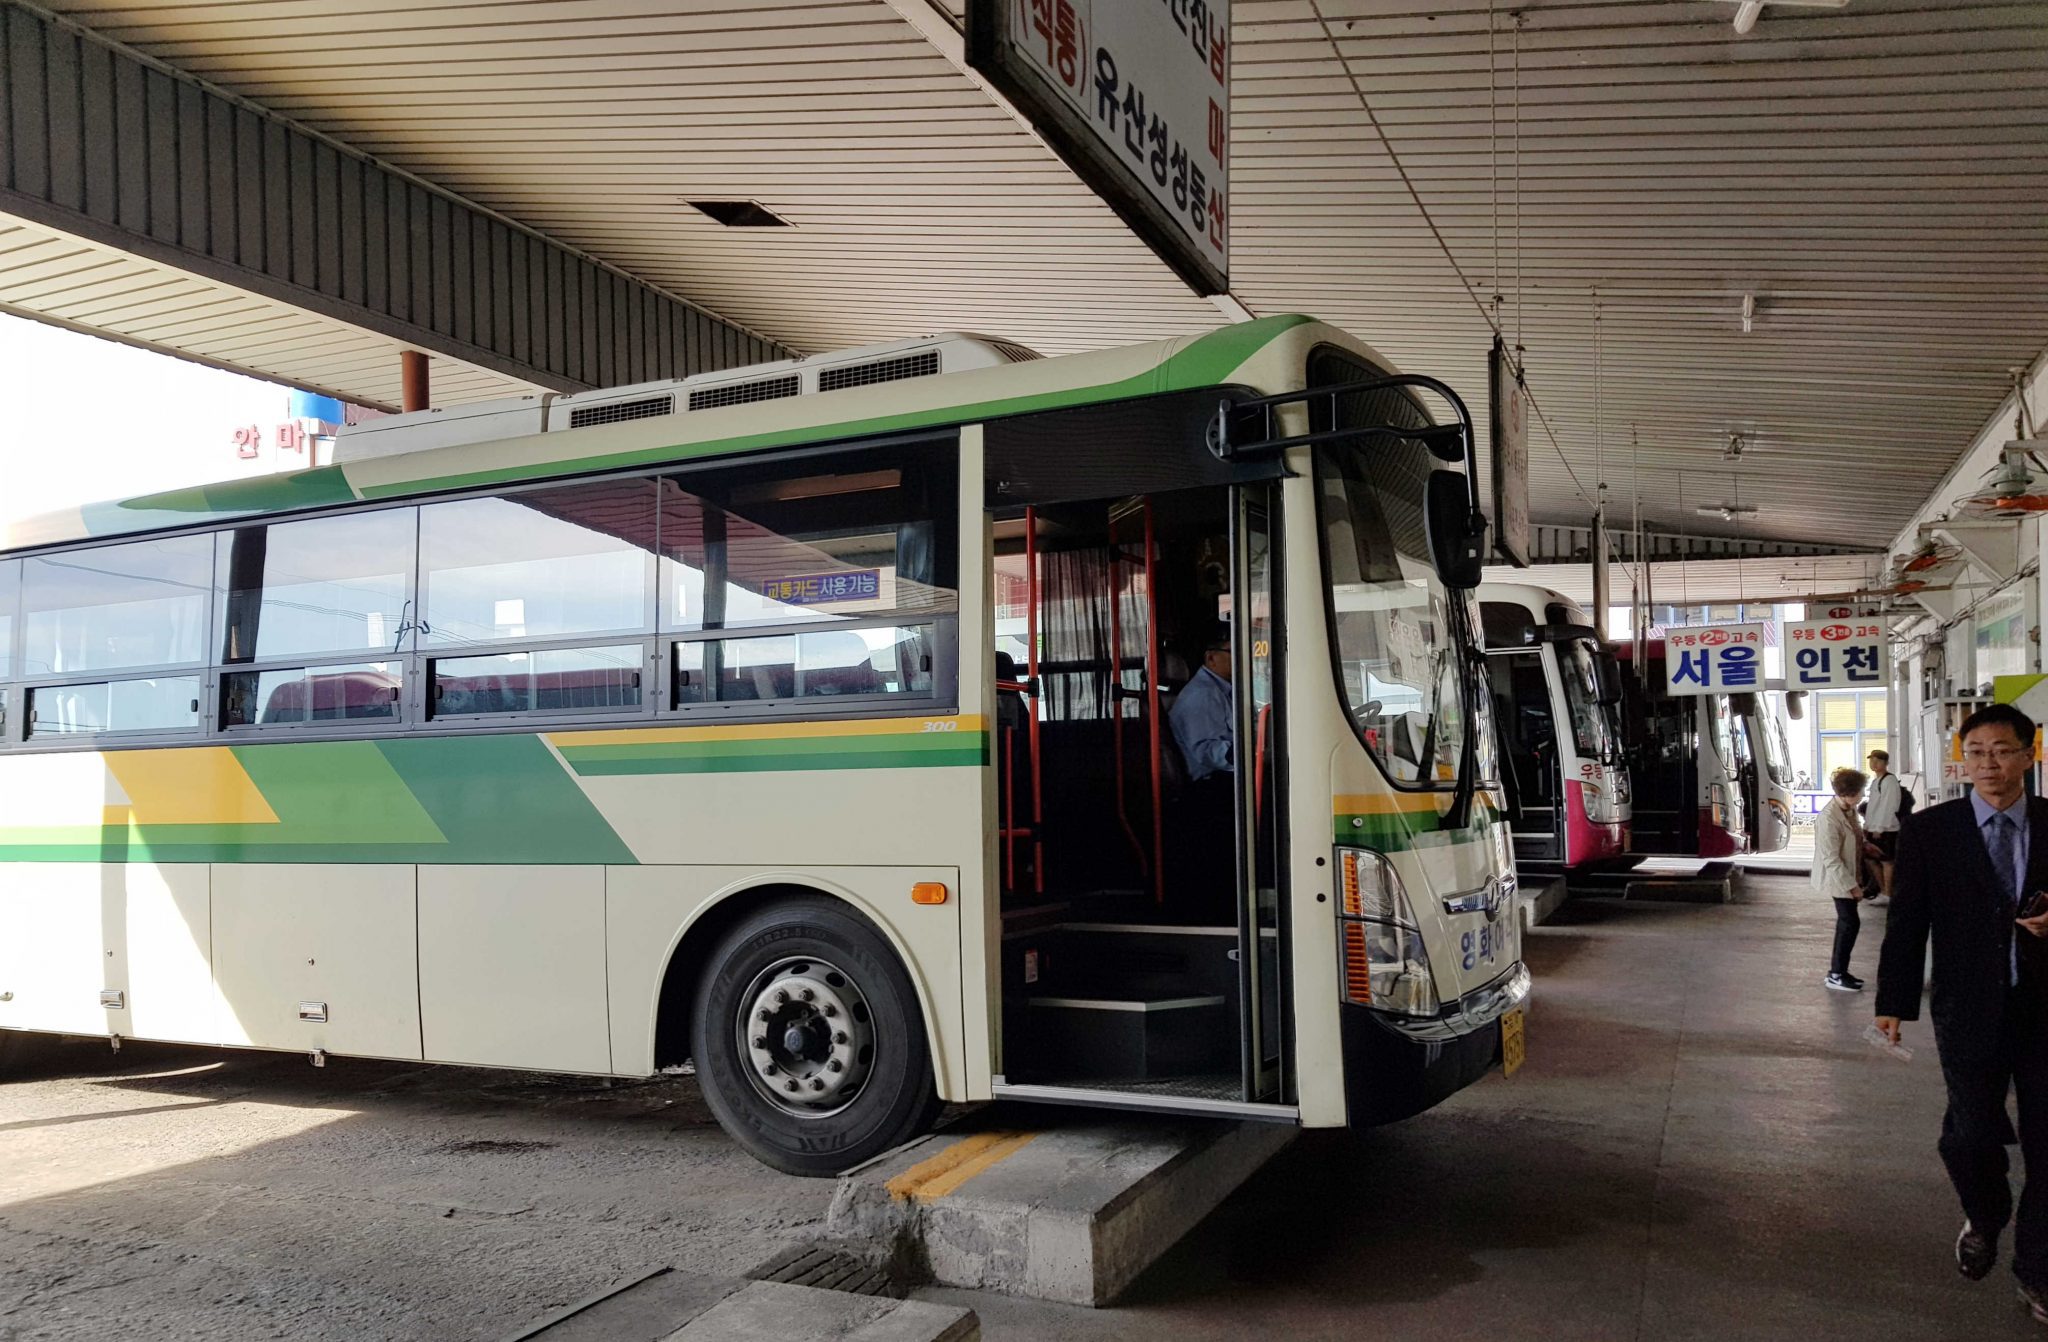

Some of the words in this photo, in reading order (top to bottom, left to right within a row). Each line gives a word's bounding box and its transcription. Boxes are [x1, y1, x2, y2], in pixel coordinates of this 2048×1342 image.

[1670, 635, 1696, 647] 우등
[1731, 631, 1759, 643] 고속
[1792, 629, 1815, 641] 우등
[1856, 625, 1880, 637] 고속
[1254, 640, 1269, 657] 20
[1671, 646, 1760, 686] 서울
[1795, 645, 1880, 684] 인천
[920, 721, 957, 733] 300
